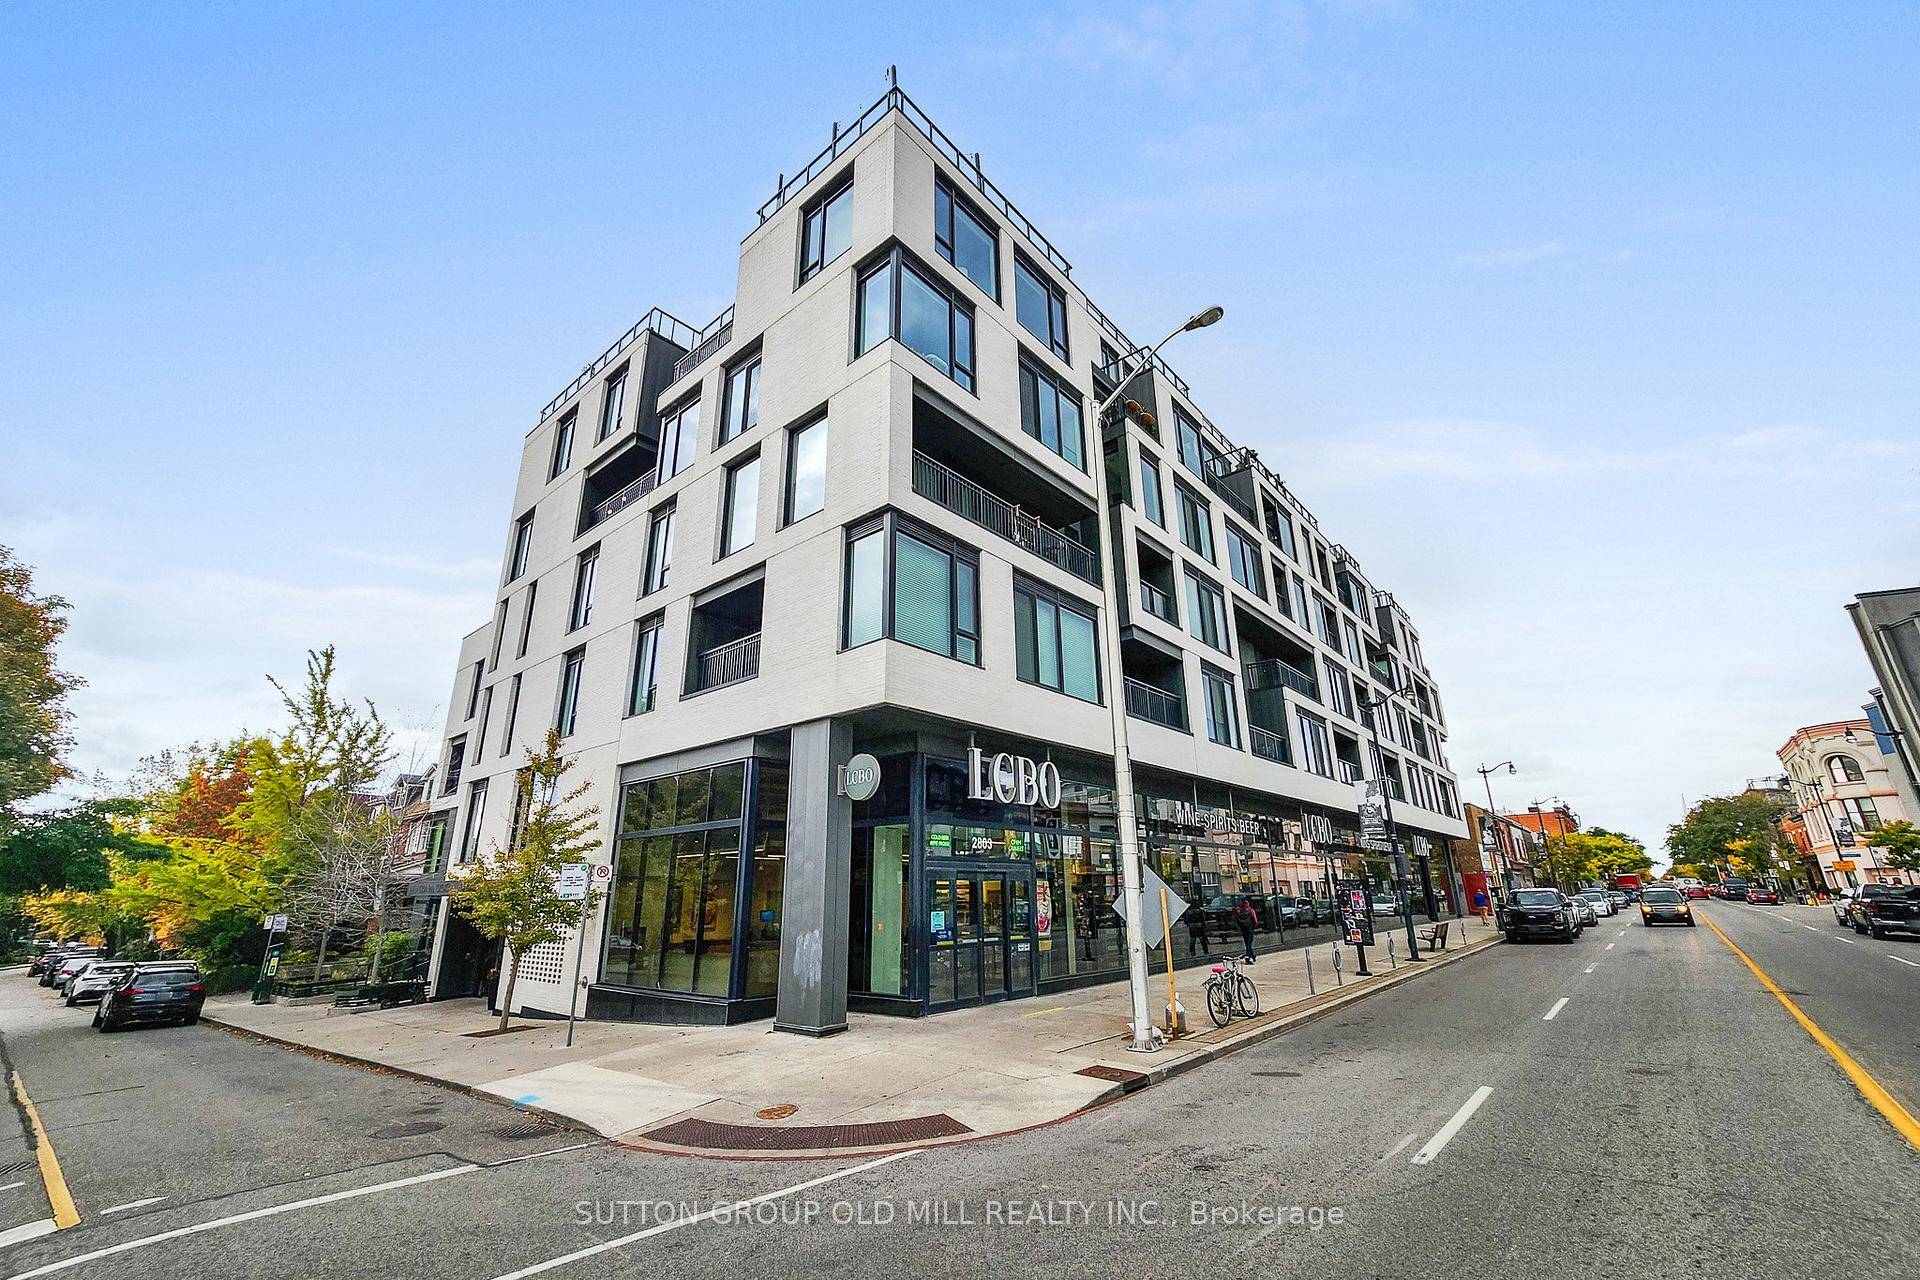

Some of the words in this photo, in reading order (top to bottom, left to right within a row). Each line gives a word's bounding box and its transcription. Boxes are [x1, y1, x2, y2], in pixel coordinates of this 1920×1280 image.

[846, 768, 873, 785] LCBO
[967, 747, 1061, 809] LCBO
[1303, 813, 1333, 845] LCBO
